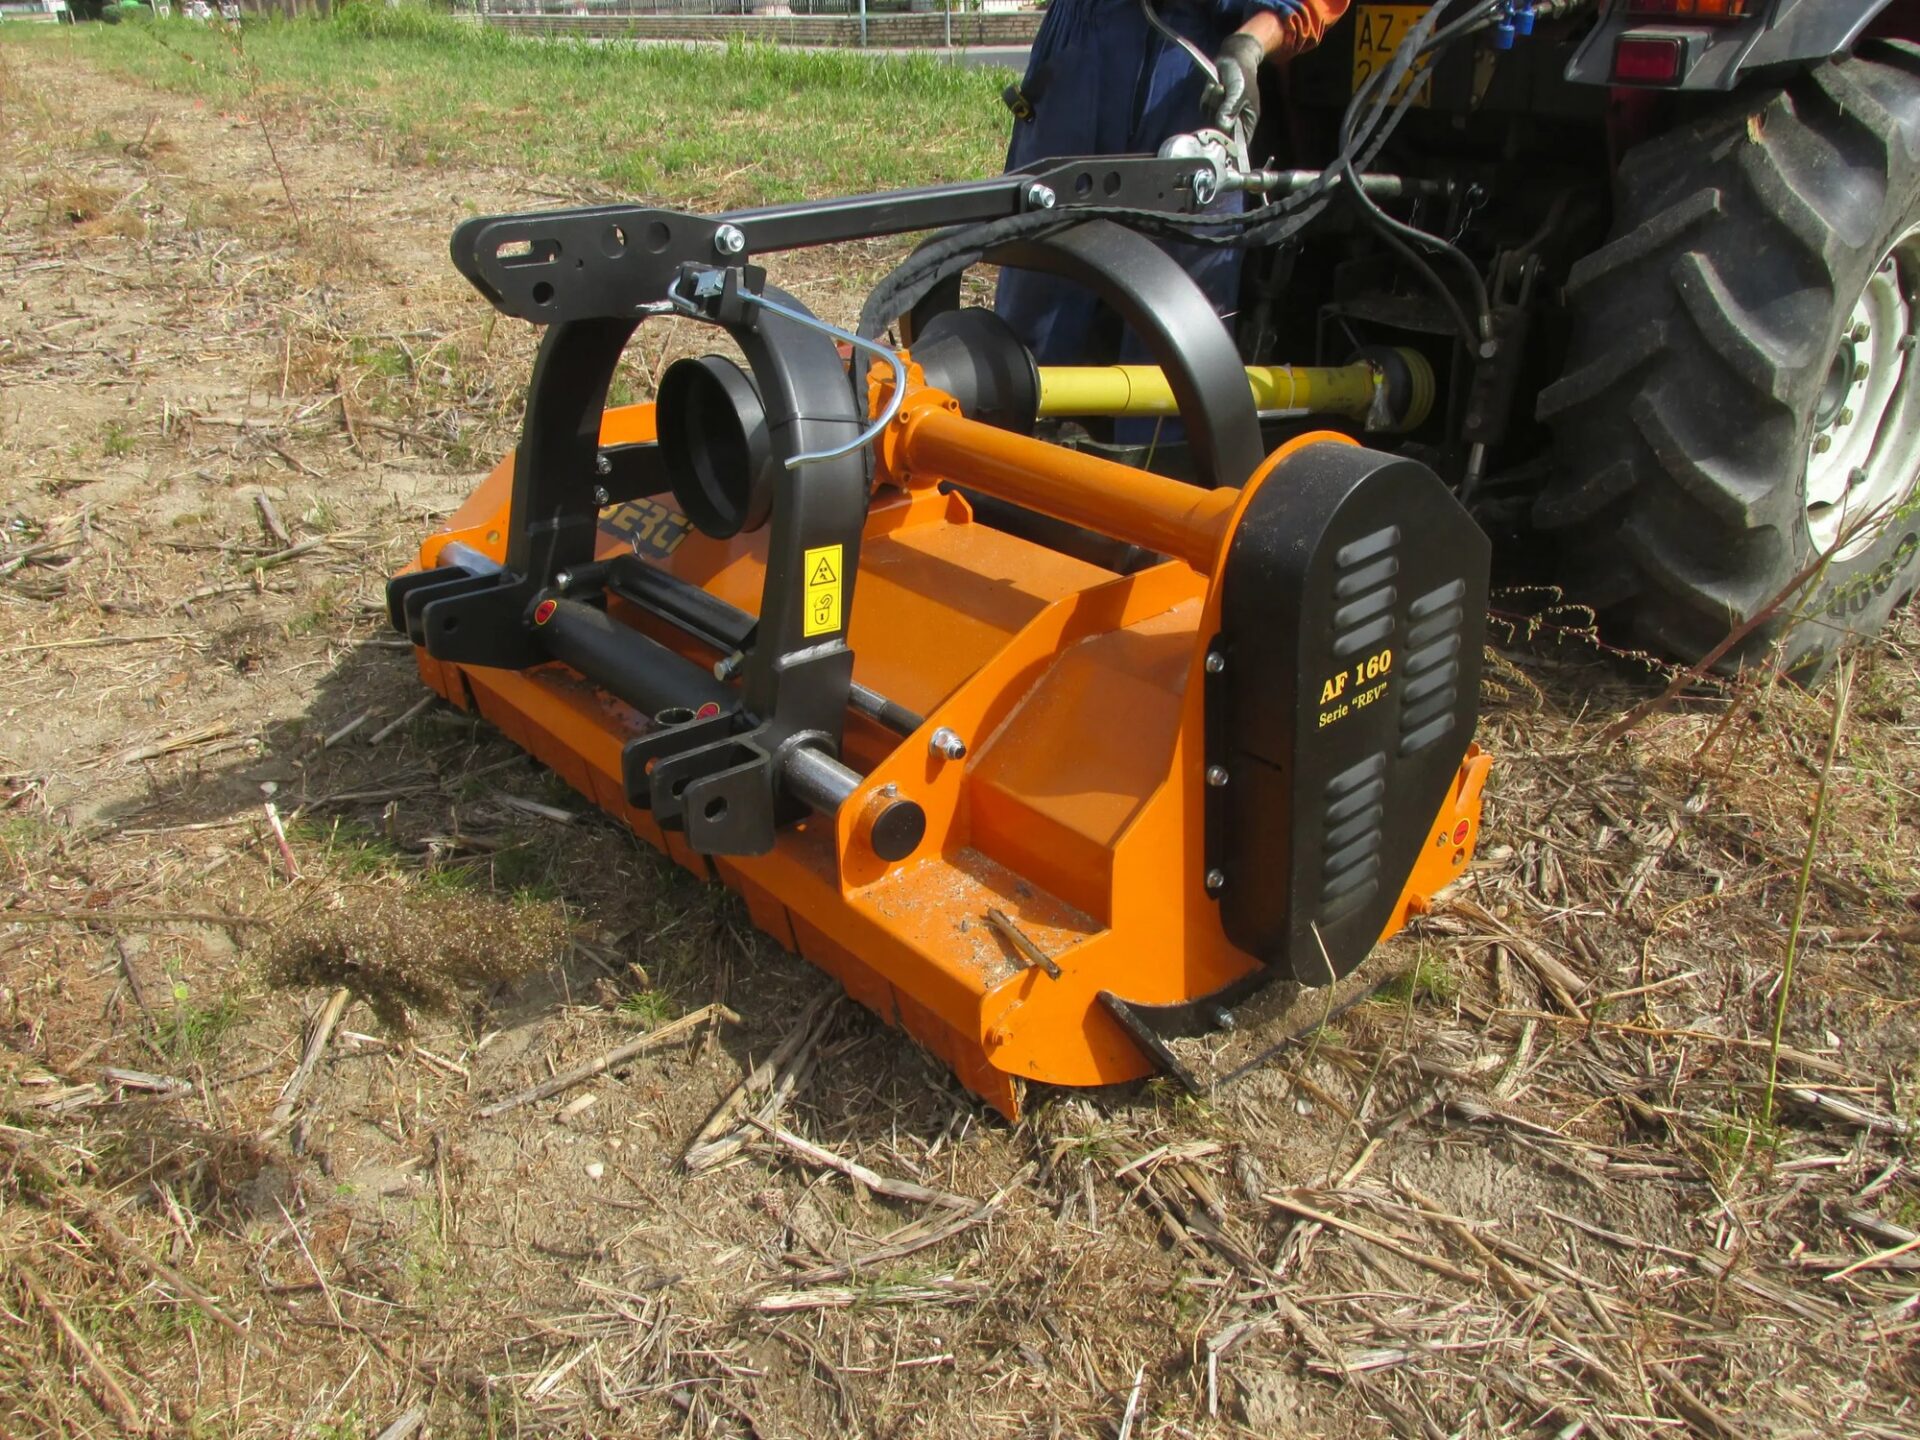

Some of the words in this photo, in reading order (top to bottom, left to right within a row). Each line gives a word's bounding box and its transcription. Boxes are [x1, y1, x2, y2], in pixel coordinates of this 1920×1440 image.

[1320, 671, 1348, 705] AF
[1355, 649, 1392, 686] 160
[1319, 704, 1348, 728] Serie
